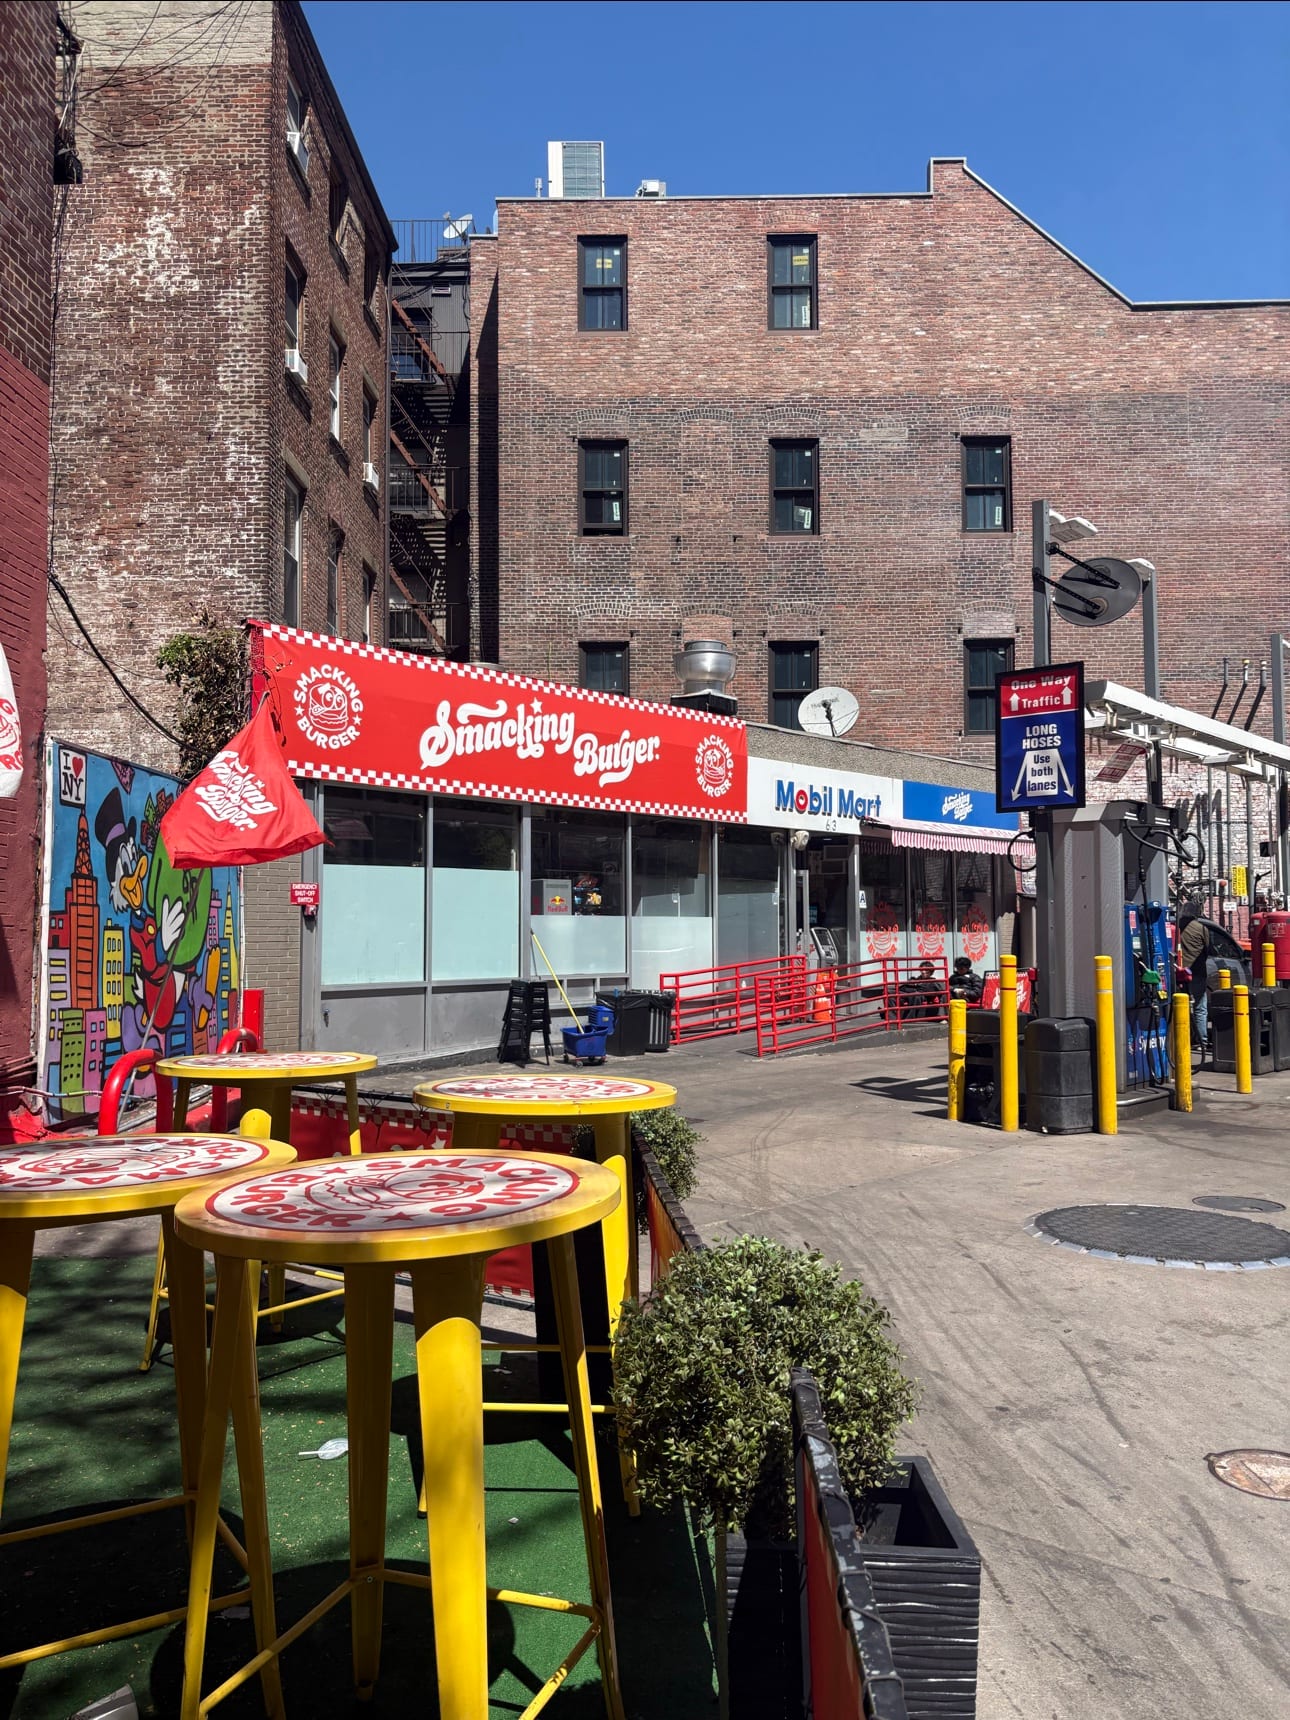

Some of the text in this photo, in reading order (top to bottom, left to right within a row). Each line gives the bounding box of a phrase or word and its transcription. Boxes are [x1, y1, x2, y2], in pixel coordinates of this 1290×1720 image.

[294, 664, 363, 712] SMACKING
[1011, 675, 1071, 690] One Way
[1022, 695, 1060, 708] Traffic
[297, 716, 360, 749] BURGER
[420, 697, 575, 770] Smacking
[1026, 724, 1058, 737] LONG
[695, 734, 734, 769] SMACKING
[1022, 735, 1062, 750] HOSES
[63, 751, 71, 770] I
[1033, 754, 1050, 764] Use
[1031, 767, 1053, 777] both
[62, 771, 84, 801] NY
[697, 774, 732, 797] BURGER
[1028, 780, 1056, 792] lanes
[776, 779, 882, 819] Mobil Mart
[366, 1158, 558, 1217] SMACKING
[230, 1173, 366, 1227] BURGER
